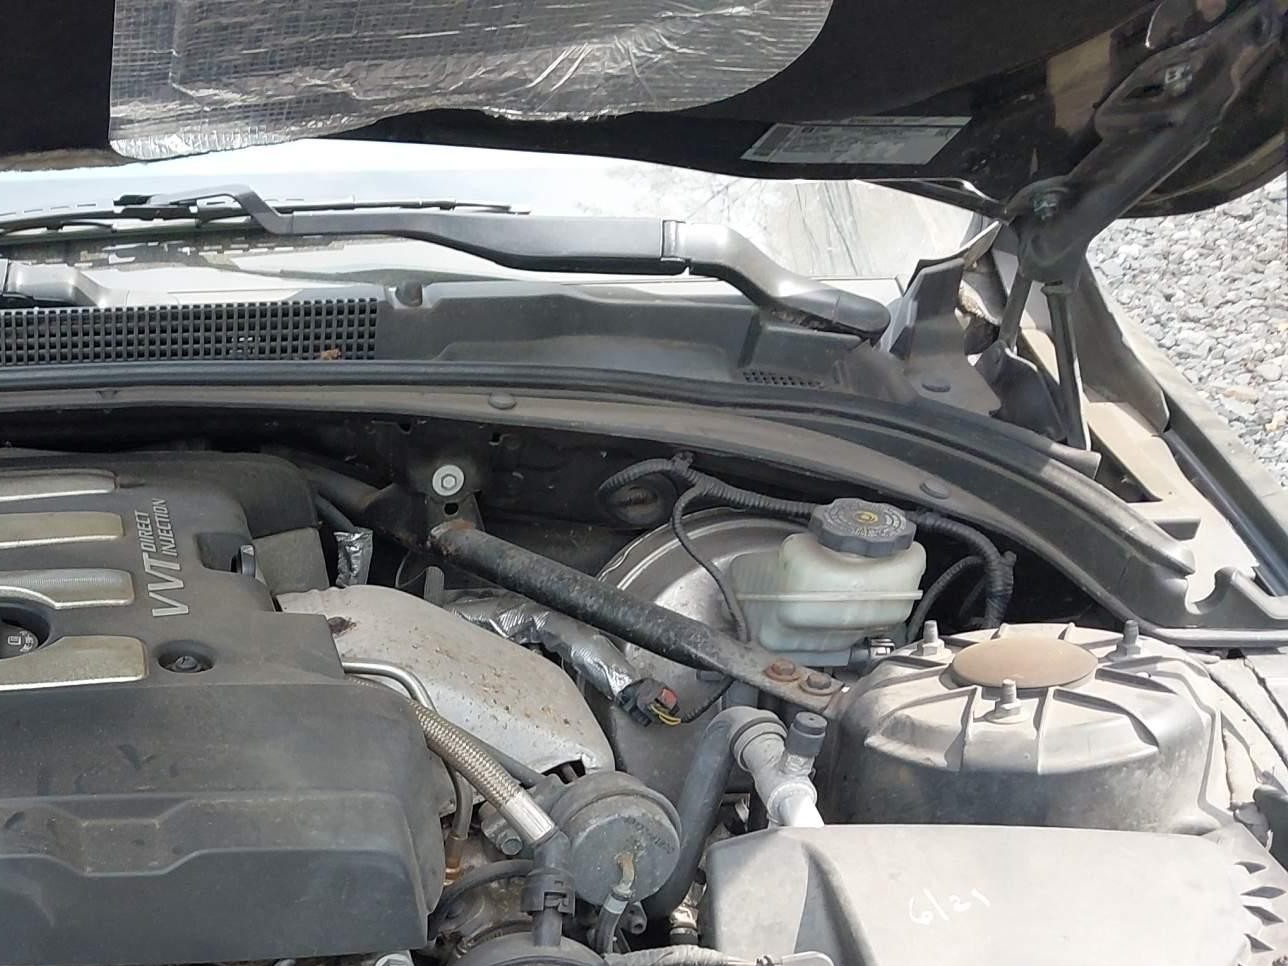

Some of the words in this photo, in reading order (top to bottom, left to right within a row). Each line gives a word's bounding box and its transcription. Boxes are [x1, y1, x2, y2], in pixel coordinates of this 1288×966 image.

[134, 510, 157, 553] DIRECT
[152, 498, 178, 557] INJECTION
[143, 552, 189, 617] VVT
